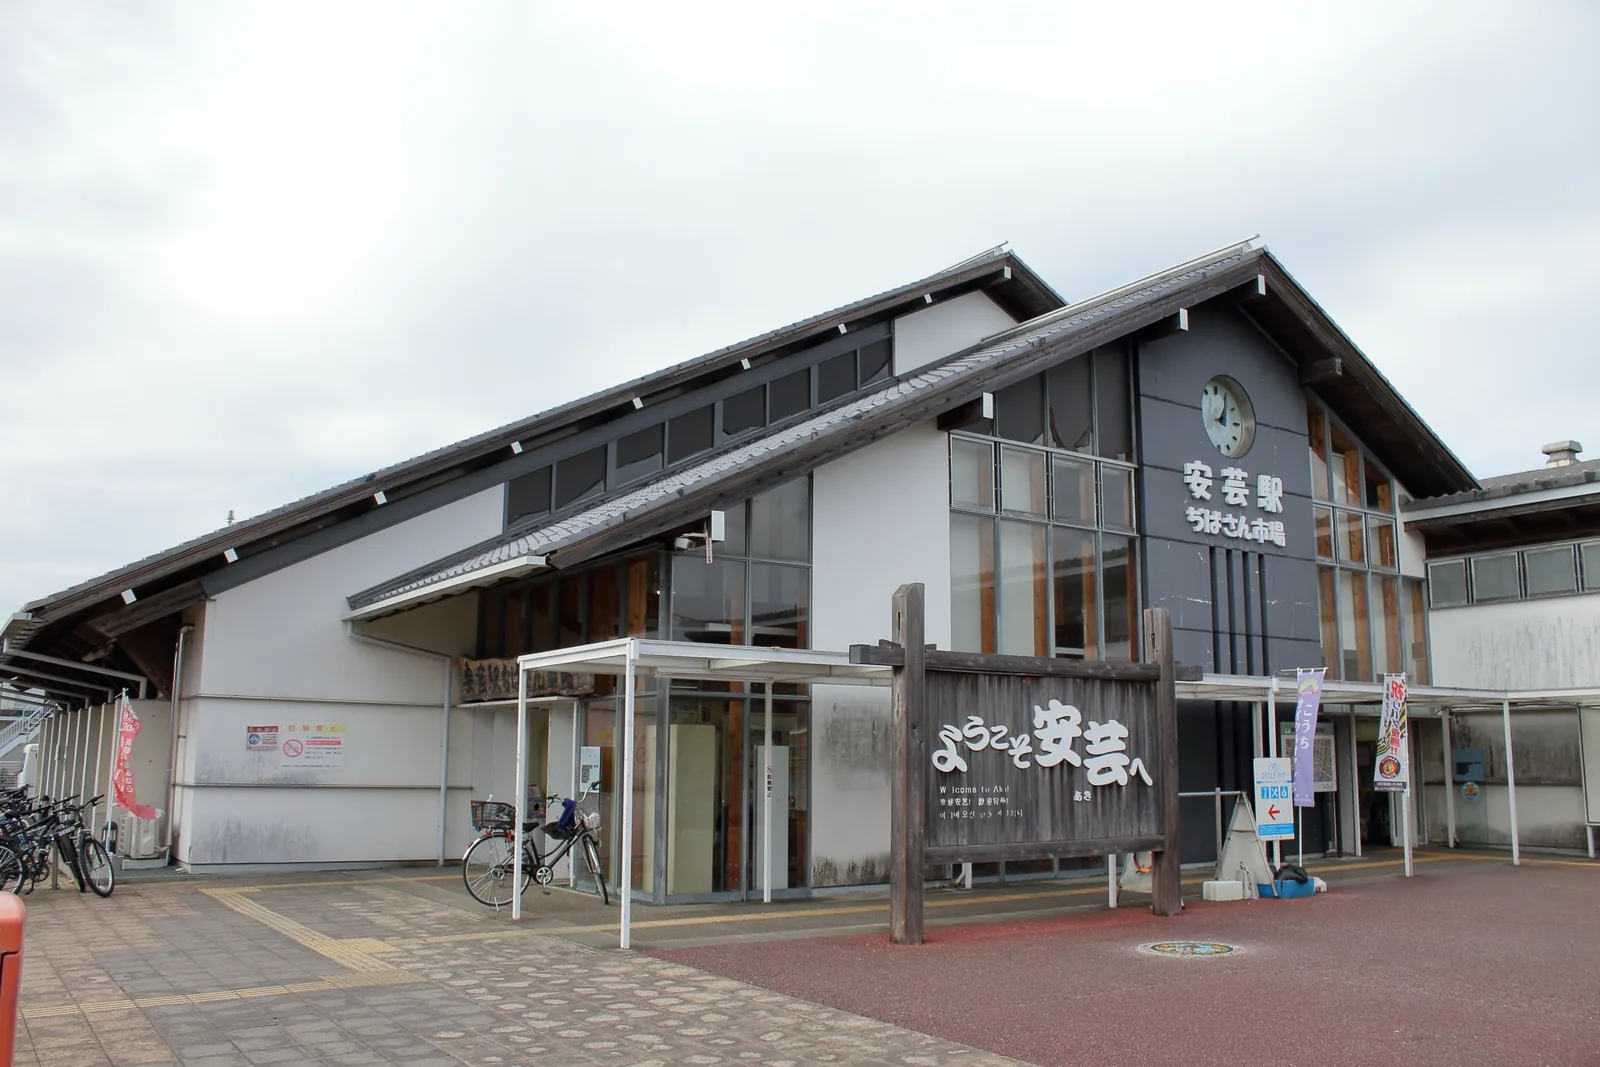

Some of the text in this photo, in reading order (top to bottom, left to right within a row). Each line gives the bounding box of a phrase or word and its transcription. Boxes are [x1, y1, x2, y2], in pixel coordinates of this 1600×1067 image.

[1183, 460, 1284, 514] 安芸駅
[1185, 506, 1286, 547] ぢばさん市場
[932, 698, 1153, 787] ようこそ安芸へ
[1300, 704, 1313, 749] こうち
[939, 785, 977, 794] Wlcome
[1073, 790, 1092, 802] あき
